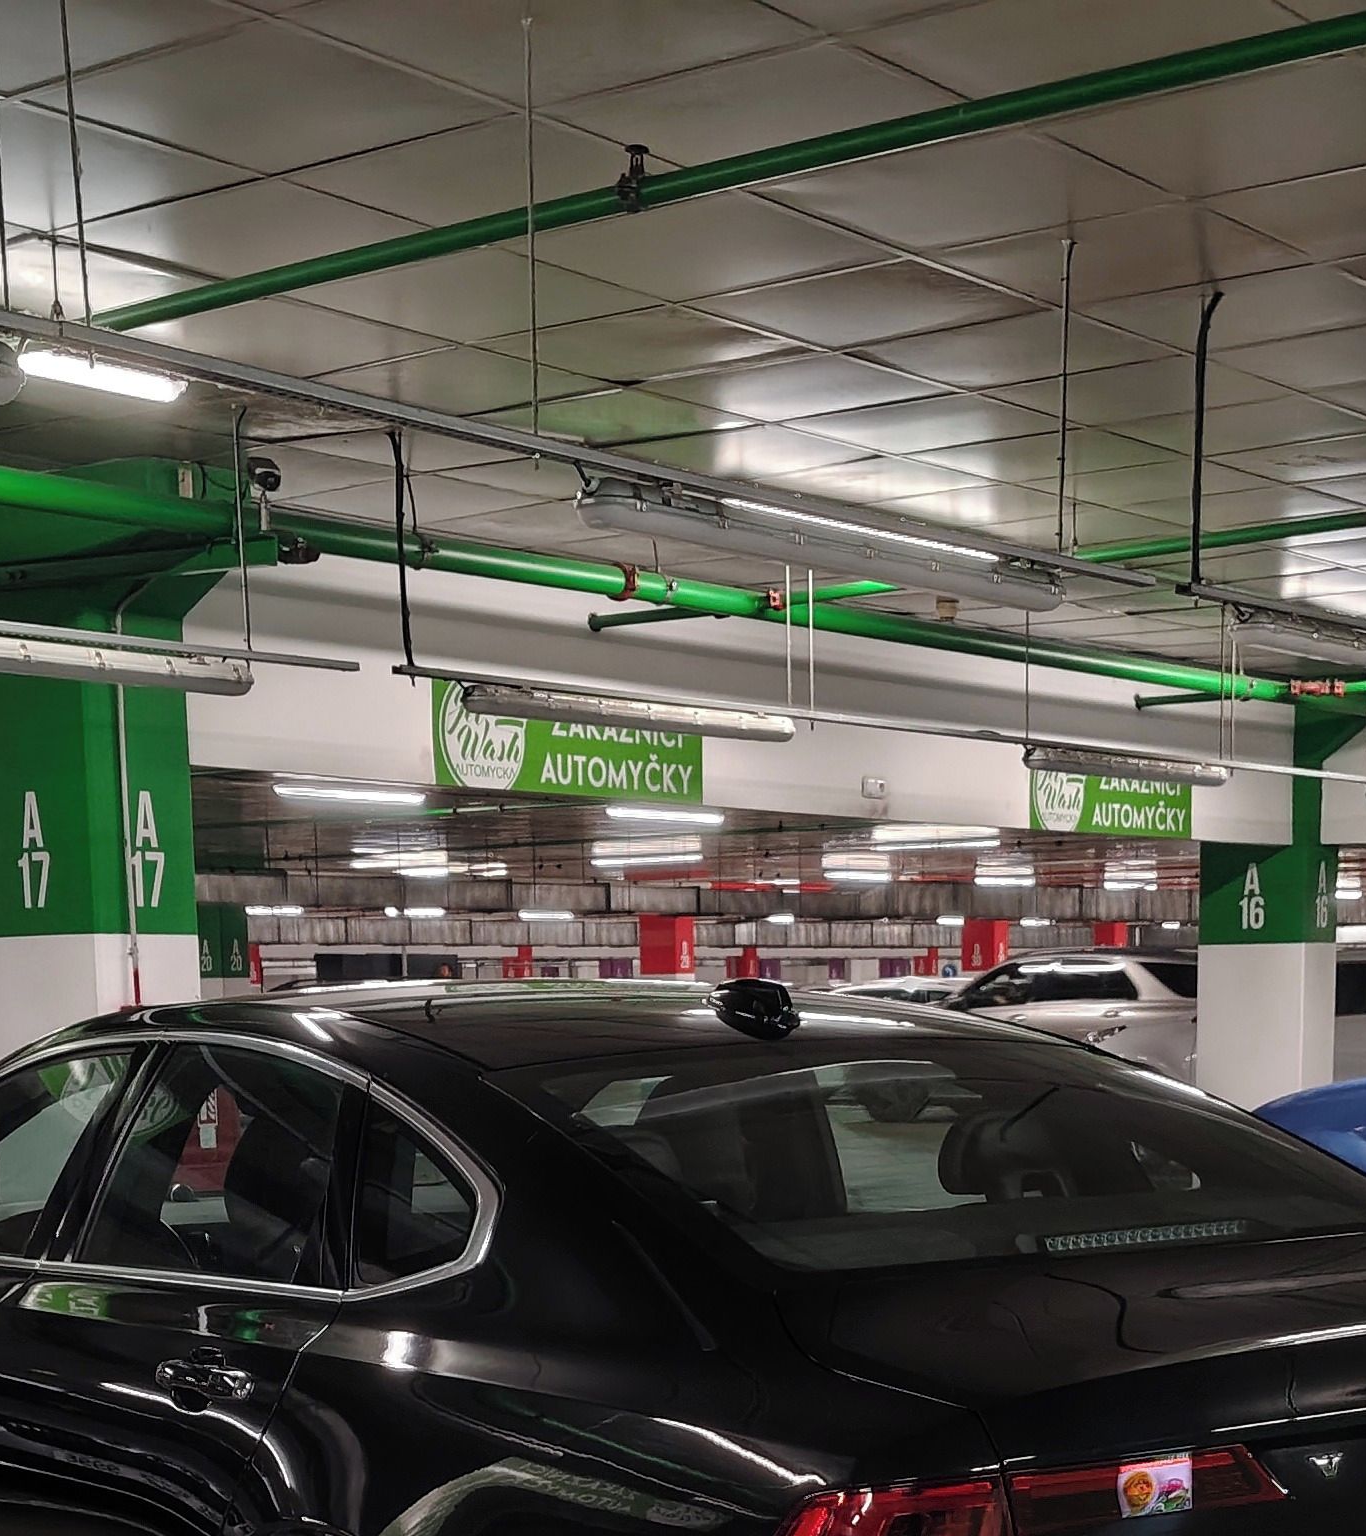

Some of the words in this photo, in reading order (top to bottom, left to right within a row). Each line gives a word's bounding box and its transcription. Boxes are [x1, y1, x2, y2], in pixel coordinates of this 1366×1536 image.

[456, 718, 521, 763] Wash
[540, 753, 693, 795] AUTOMYČKY
[22, 791, 44, 848] A
[135, 790, 158, 848] A
[1091, 801, 1186, 832] AUTOMYČKY
[17, 852, 50, 909] 17
[131, 850, 165, 908] 17
[1243, 862, 1260, 895] A
[1317, 861, 1326, 893] A
[1239, 896, 1265, 929] 16
[1315, 895, 1328, 928] 16
[200, 955, 212, 971] 20
[202, 939, 209, 955] A
[230, 954, 242, 971] 20
[233, 939, 239, 954] A
